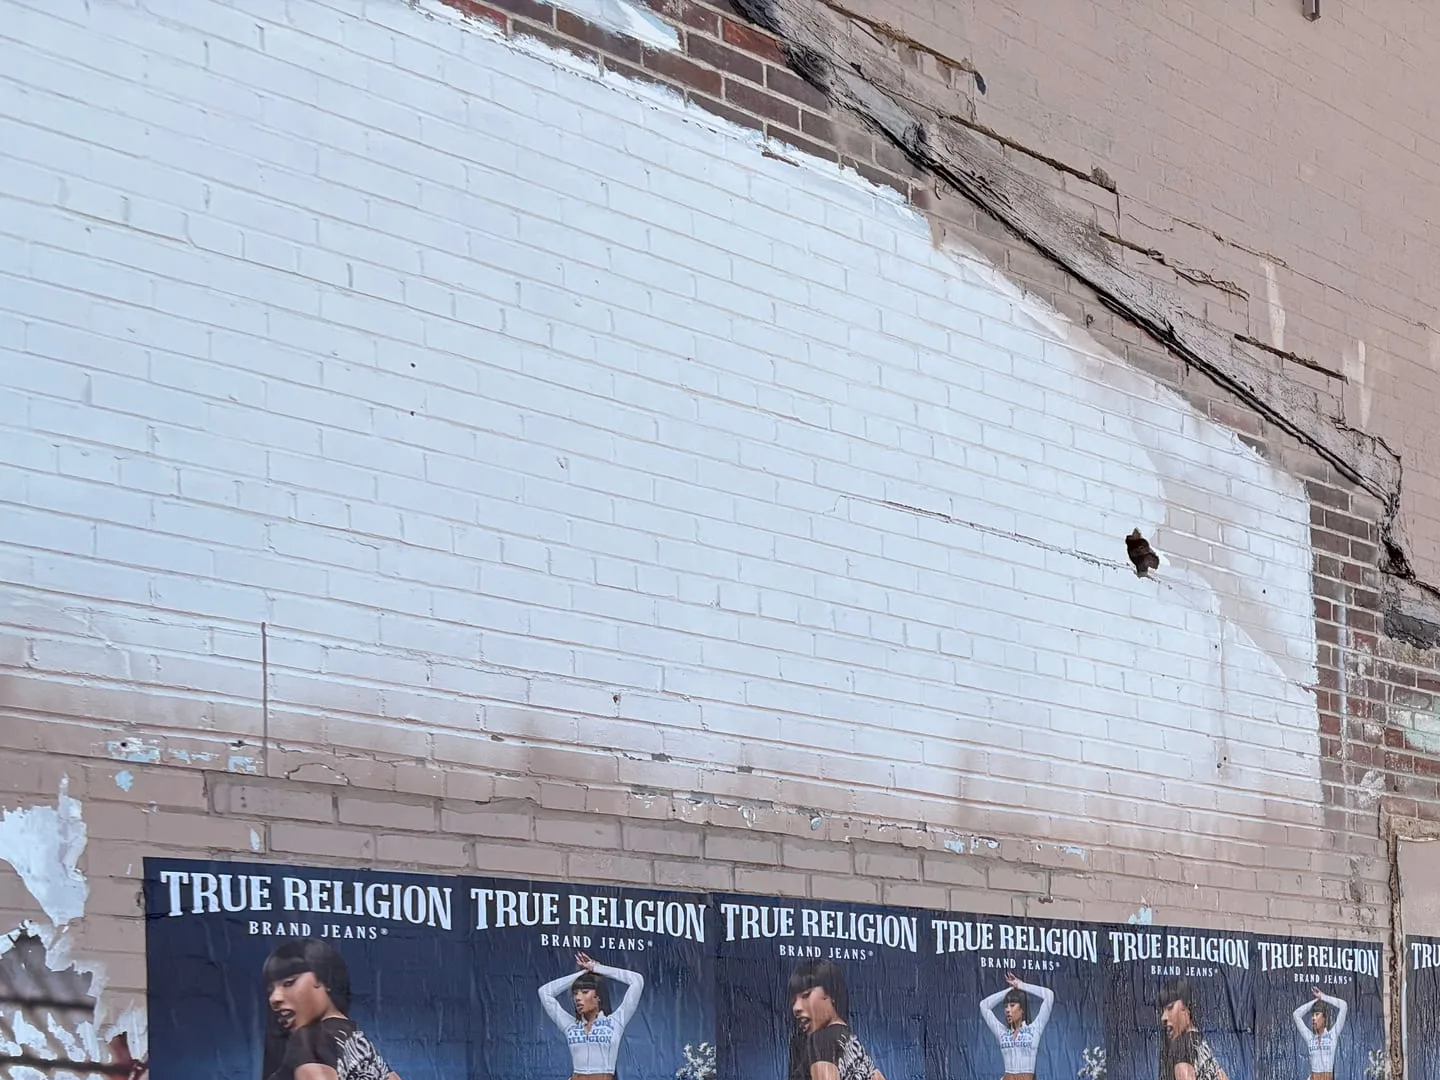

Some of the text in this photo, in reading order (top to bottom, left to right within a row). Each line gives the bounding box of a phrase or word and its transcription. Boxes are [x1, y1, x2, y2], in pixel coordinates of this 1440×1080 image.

[160, 871, 451, 929] TRUE RELIGION
[471, 889, 704, 942] TRUE RELIGION
[720, 904, 916, 951] TRUE RELIGION
[248, 921, 311, 936] BRAND
[540, 933, 590, 948] BRAND
[931, 920, 1096, 962] TRUE RELIGION
[779, 944, 821, 957] BRAND
[980, 957, 1016, 968] BRAND
[1109, 932, 1248, 969] TRUE RELIGION
[1258, 942, 1378, 977] TRUE RELIGION
[1150, 965, 1180, 975] BRAND
[1294, 973, 1319, 983] BRAND
